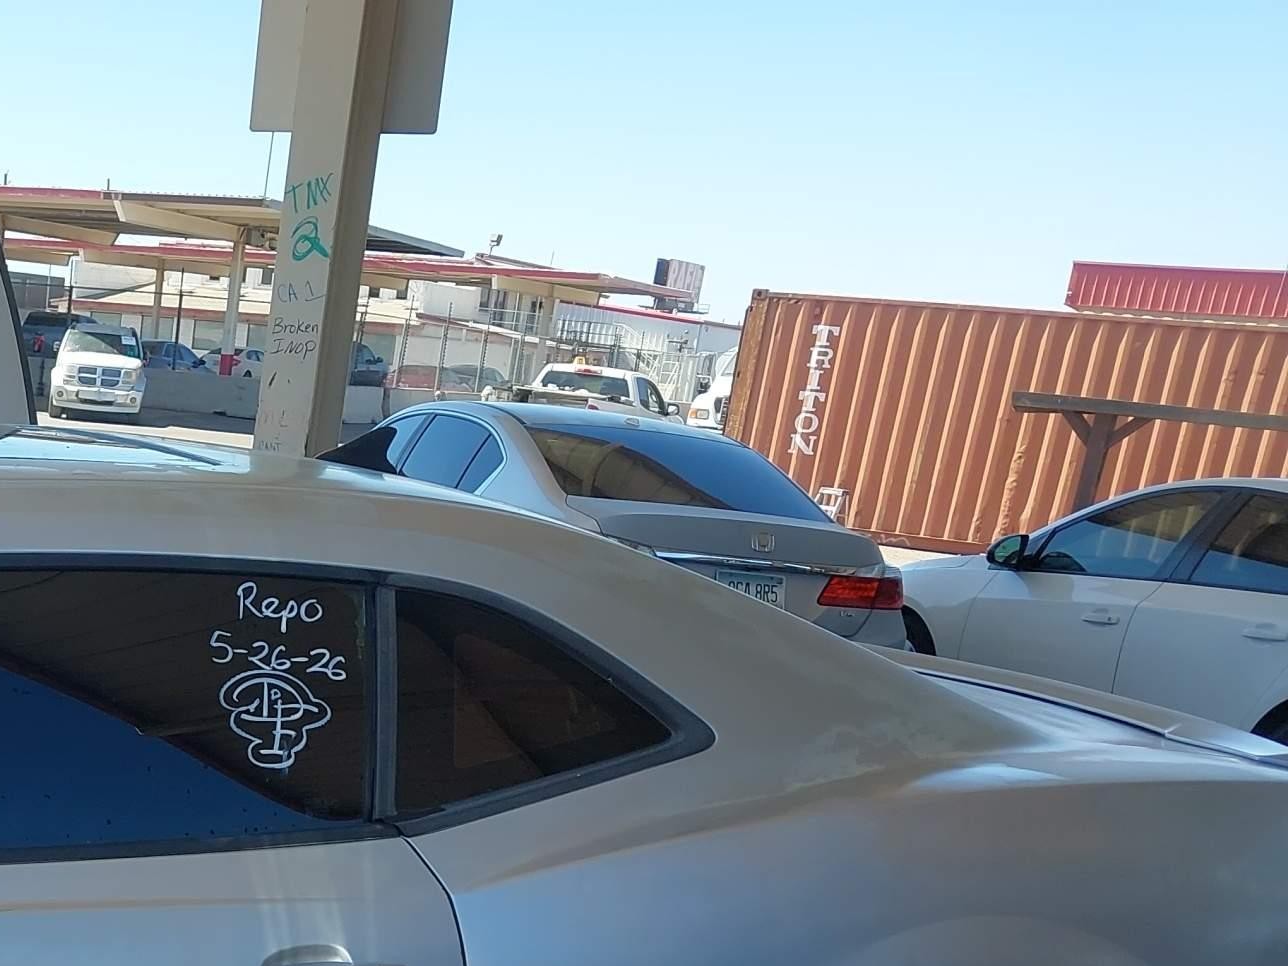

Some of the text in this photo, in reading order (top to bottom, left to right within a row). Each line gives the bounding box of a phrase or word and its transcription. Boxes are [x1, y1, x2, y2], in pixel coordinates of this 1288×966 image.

[272, 317, 319, 334] Broken
[788, 325, 840, 455] TRITON
[237, 582, 323, 633] Repo
[209, 631, 346, 680] 5-26-26
